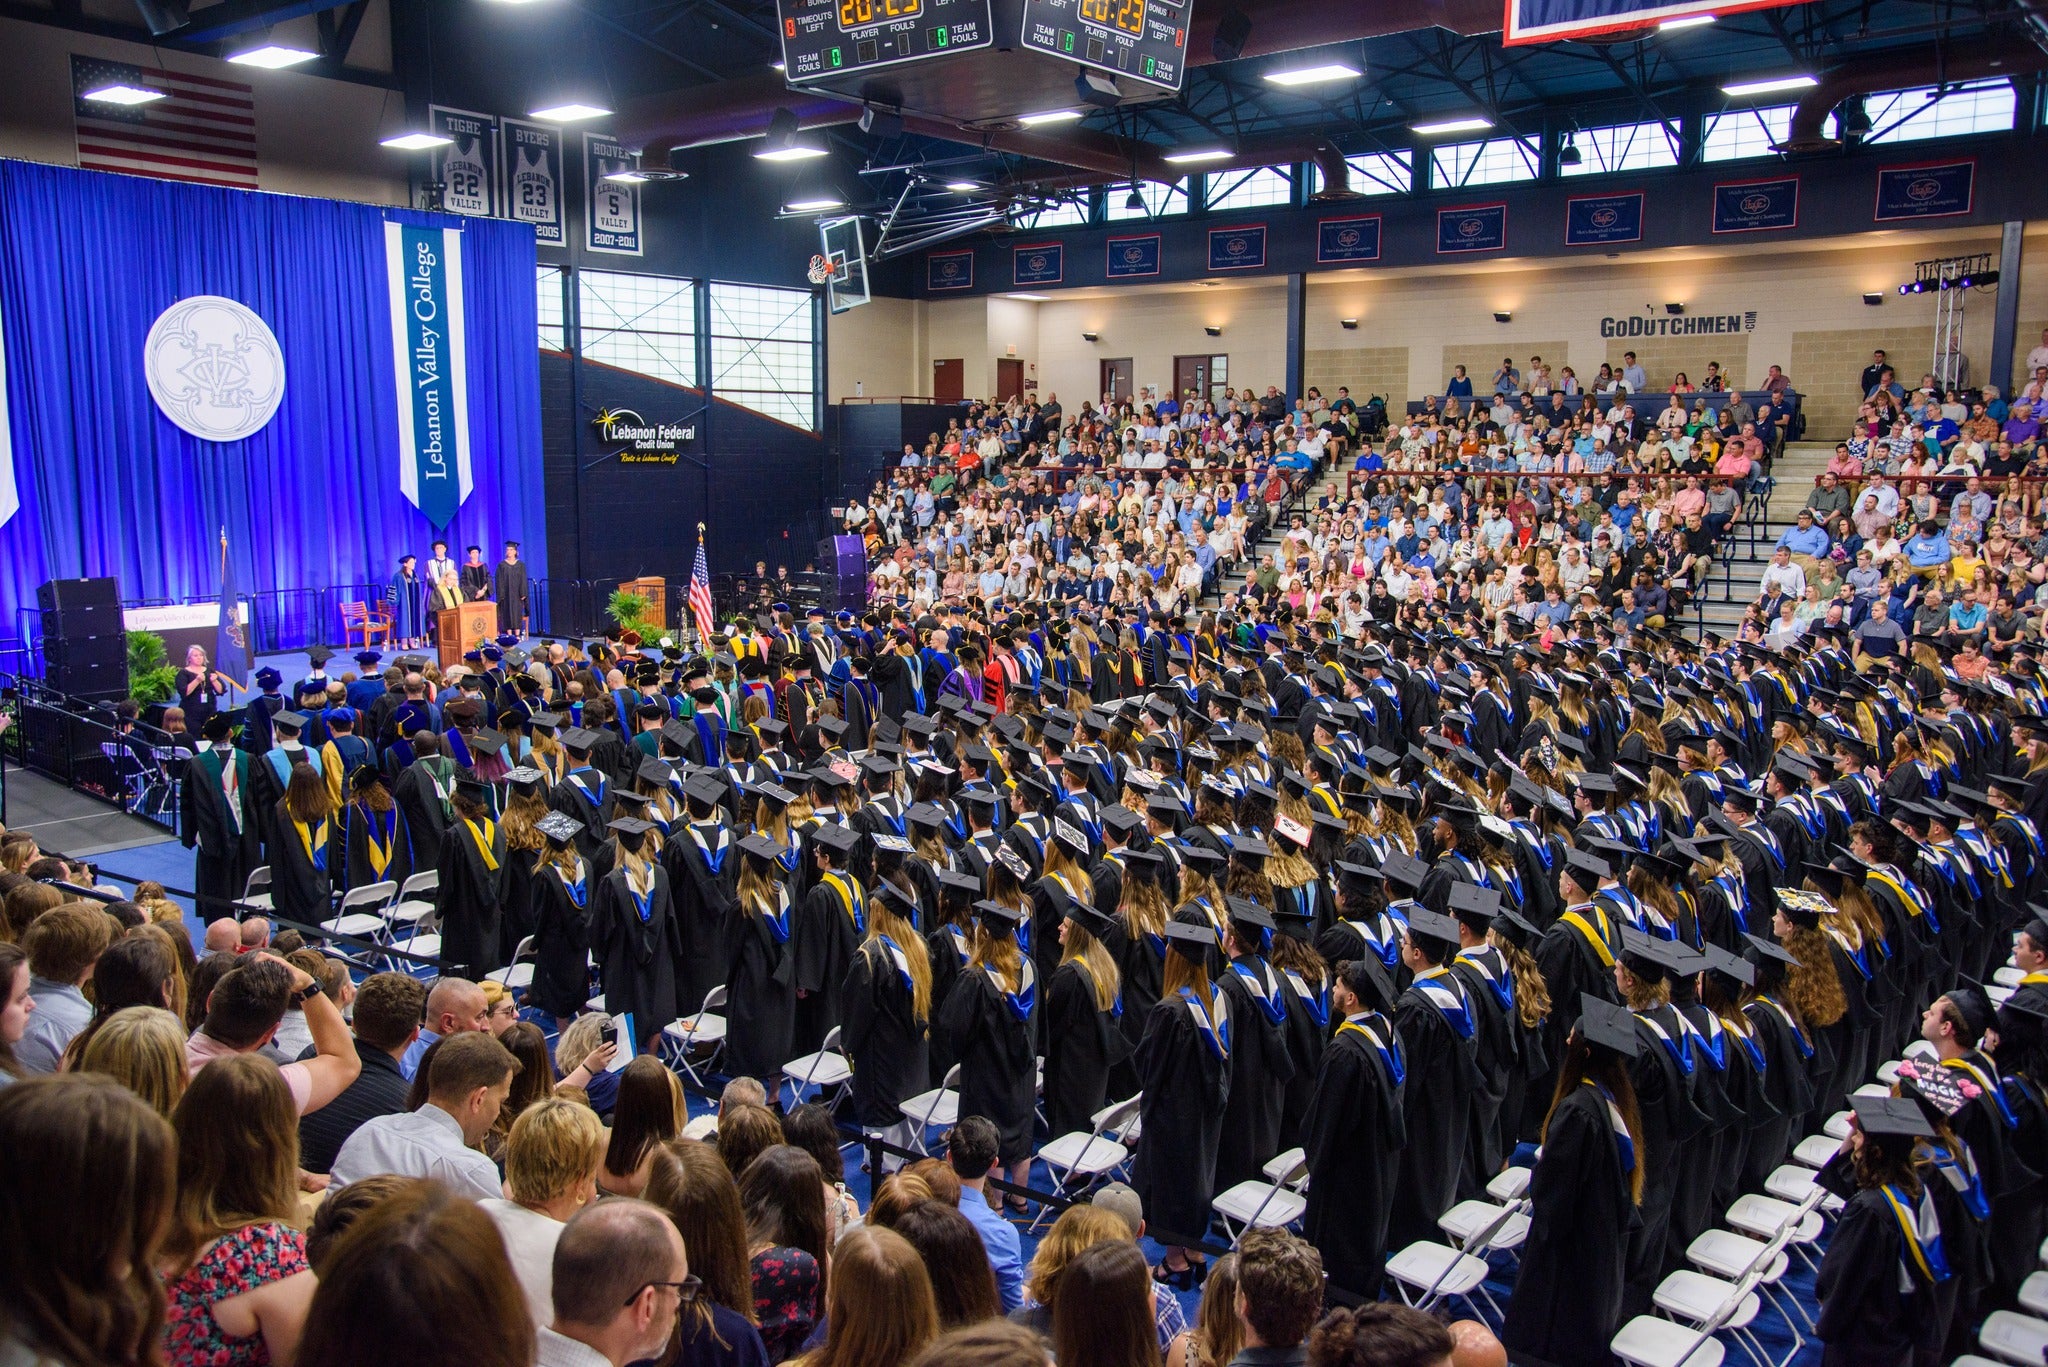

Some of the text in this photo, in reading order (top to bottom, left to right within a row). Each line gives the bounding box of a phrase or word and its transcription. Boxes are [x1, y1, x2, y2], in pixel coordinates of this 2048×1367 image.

[1148, 3, 1167, 17] BONUS
[796, 11, 833, 26] TIMEOUTS
[806, 22, 824, 33] LEFT
[852, 28, 879, 40] PLAYER
[890, 21, 915, 33] FOULS
[952, 22, 976, 34] TEAM
[1036, 24, 1055, 37] TEAM
[1085, 26, 1108, 39] PLAYER
[1148, 19, 1176, 36] TIMEOUTS
[937, 27, 947, 47] 0
[952, 32, 978, 44] FOULS
[1033, 33, 1055, 46] FOULS
[1065, 33, 1073, 51] 0
[1115, 35, 1134, 48] FOULS
[1153, 30, 1168, 42] LEFT
[798, 53, 818, 64] TEAM
[831, 48, 840, 66] 0
[797, 62, 820, 73] FOULS
[1146, 57, 1155, 75] 0
[1157, 60, 1174, 73] TEAM
[1155, 69, 1173, 82] FOULS
[446, 117, 481, 134] TIGHE
[515, 129, 549, 146] BYERS
[447, 161, 483, 178] LEBANON
[453, 172, 479, 198] 22
[517, 174, 550, 189] LEBANON
[522, 183, 546, 206] 23
[598, 183, 629, 199] LEBANON
[450, 197, 482, 210] VALLEY
[609, 195, 619, 216] 5
[520, 206, 549, 219] VALLEY
[600, 217, 628, 228] VALLEY
[594, 233, 635, 248] 2007-2011
[411, 242, 446, 480] Lebanon Valley College
[611, 424, 695, 440] Lebanon Federal
[635, 440, 675, 449] Credit Union
[1917, 1078, 1964, 1099] MAGIC
